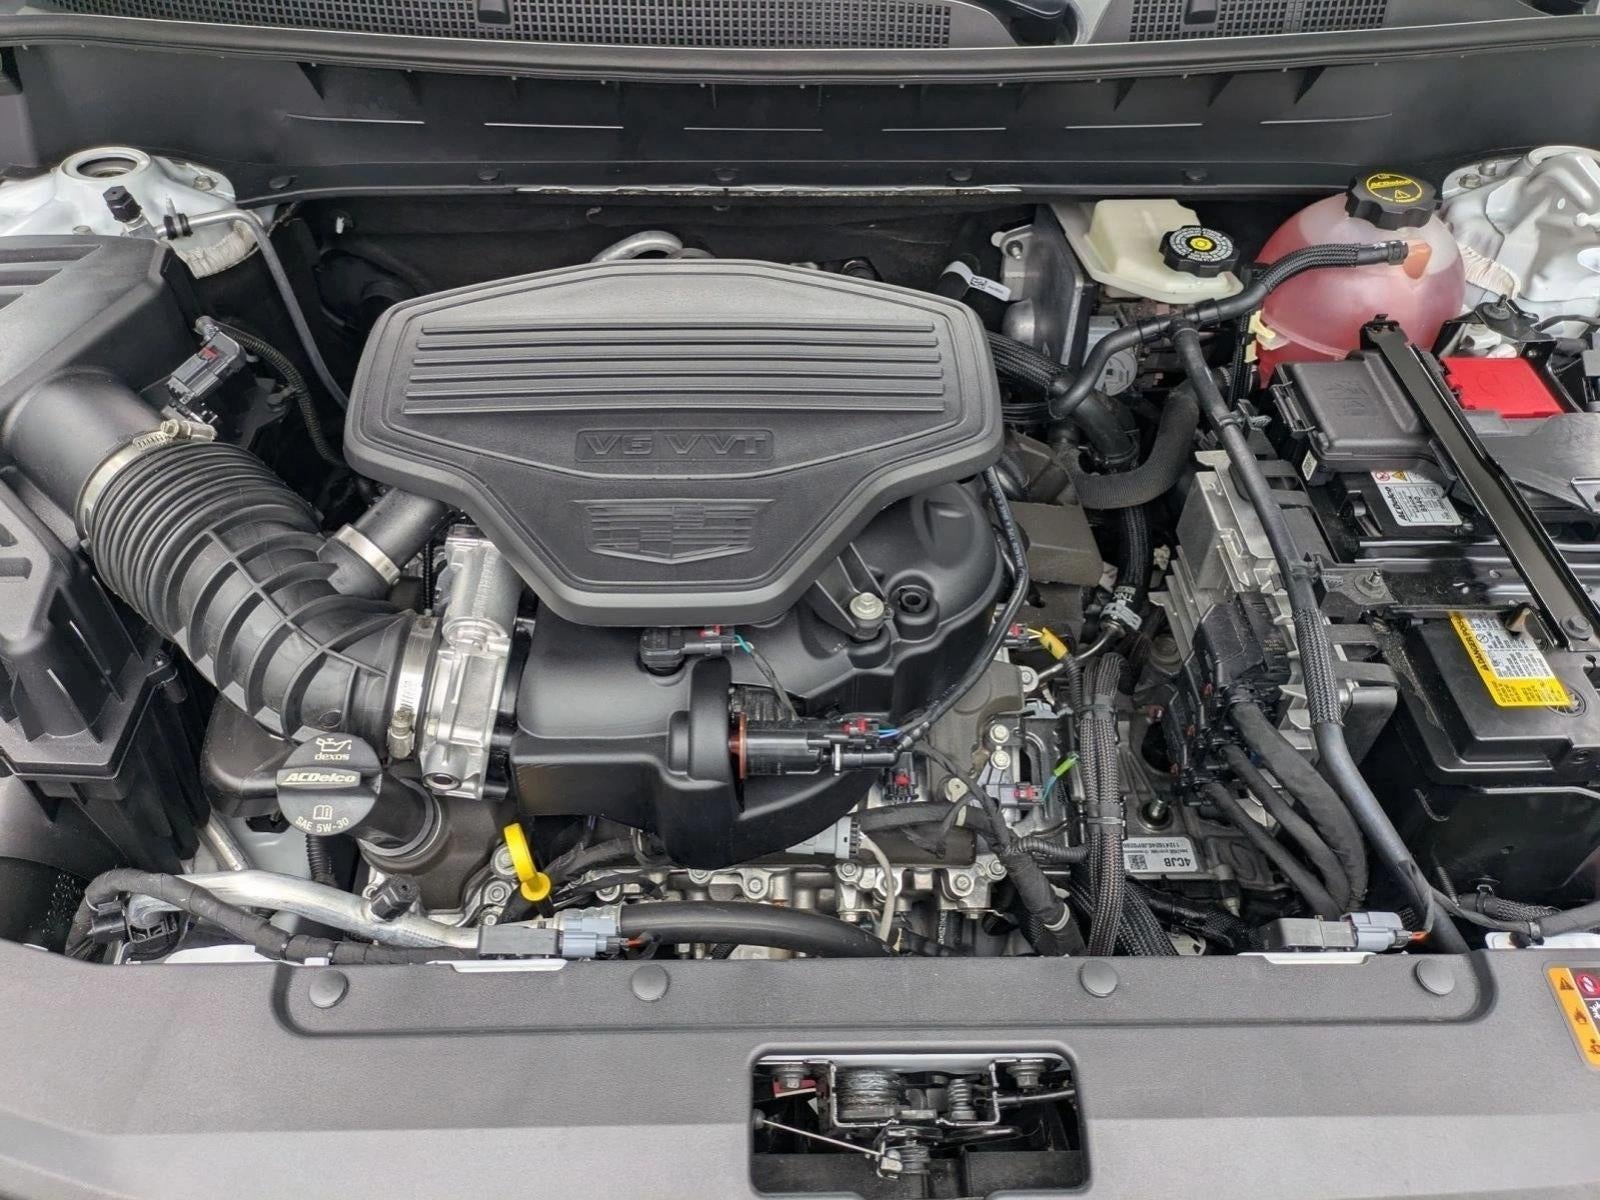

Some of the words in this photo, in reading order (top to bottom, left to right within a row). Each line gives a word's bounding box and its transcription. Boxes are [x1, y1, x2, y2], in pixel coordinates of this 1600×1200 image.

[585, 434, 653, 455] V6
[664, 434, 767, 455] VVT
[315, 752, 350, 761] dexos
[282, 772, 357, 785] ACDelco
[296, 816, 312, 831] SAE
[317, 817, 349, 832] 5W-30
[1163, 857, 1191, 867] 4CJB
